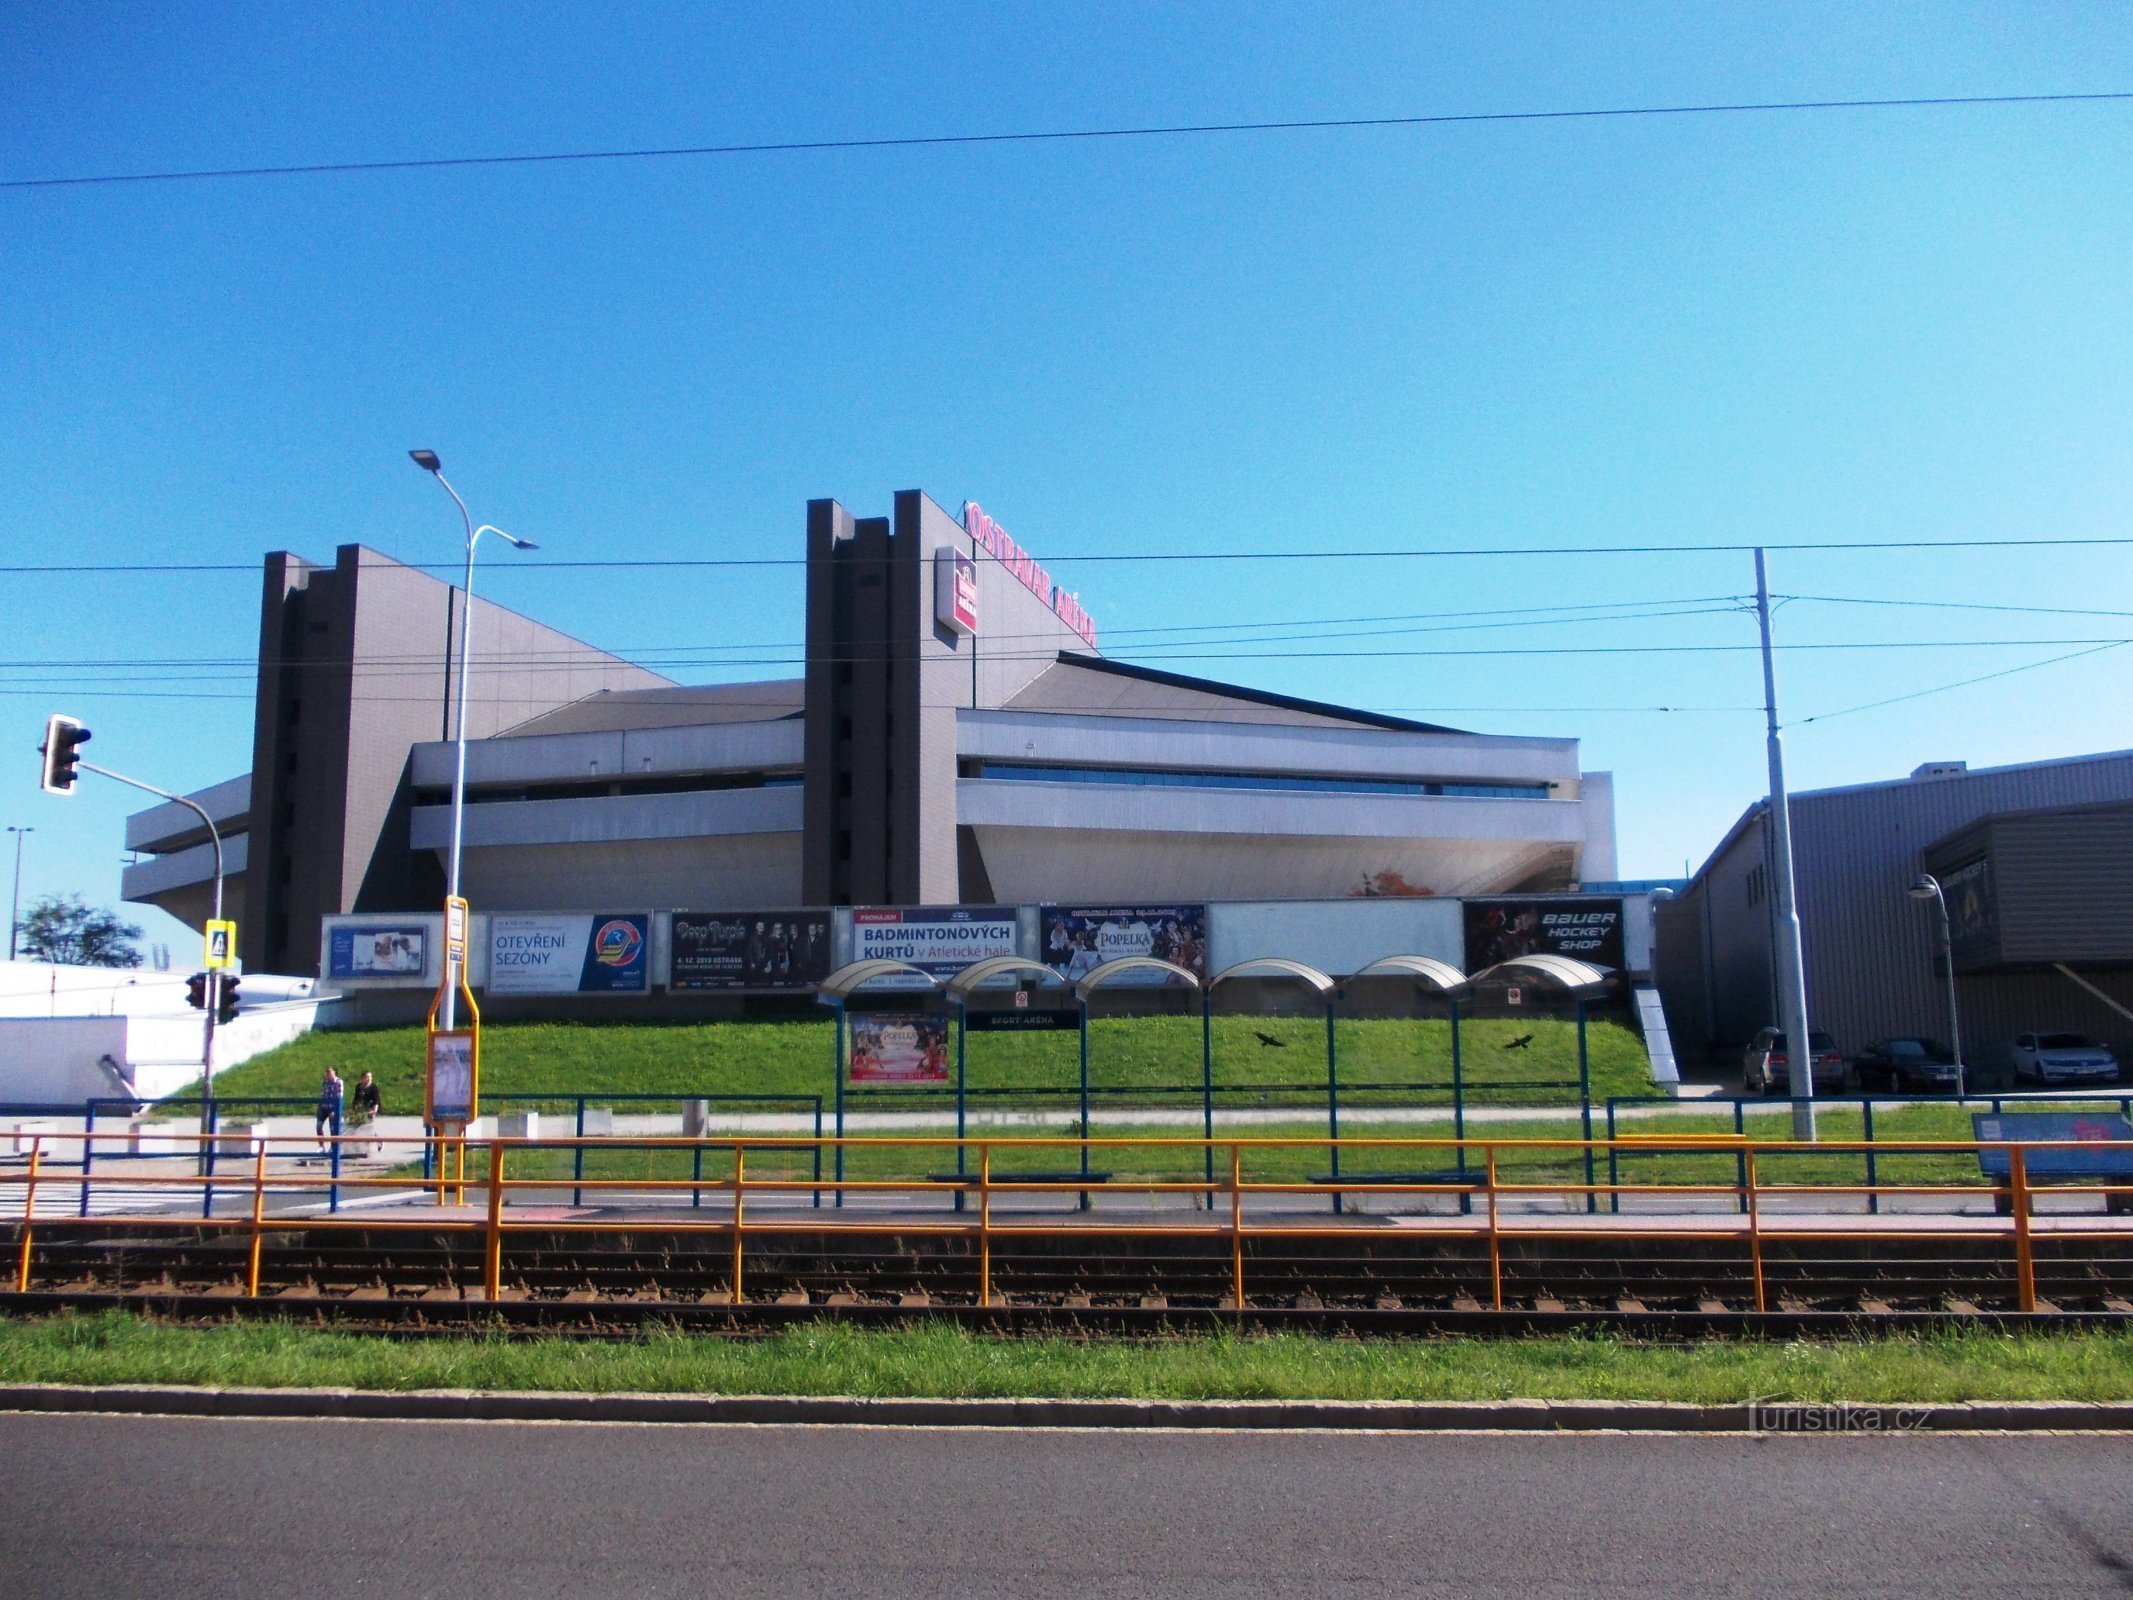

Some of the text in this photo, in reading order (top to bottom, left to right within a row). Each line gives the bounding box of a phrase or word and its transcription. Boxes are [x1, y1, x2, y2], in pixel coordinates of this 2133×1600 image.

[967, 501, 1097, 648] OSTRAVAR ARÉNA
[864, 925, 1010, 941] BADMINTONOVÝCH
[1100, 932, 1150, 947] POPELKA
[1548, 927, 1610, 938] HOCKEY
[496, 933, 565, 948] OTEVŘENÍ
[1559, 940, 1602, 950] SHOP
[496, 950, 551, 966] SEZÓNY
[864, 944, 914, 959] KURTŮ
[928, 945, 981, 958] Atletické
[984, 945, 1010, 957] hale
